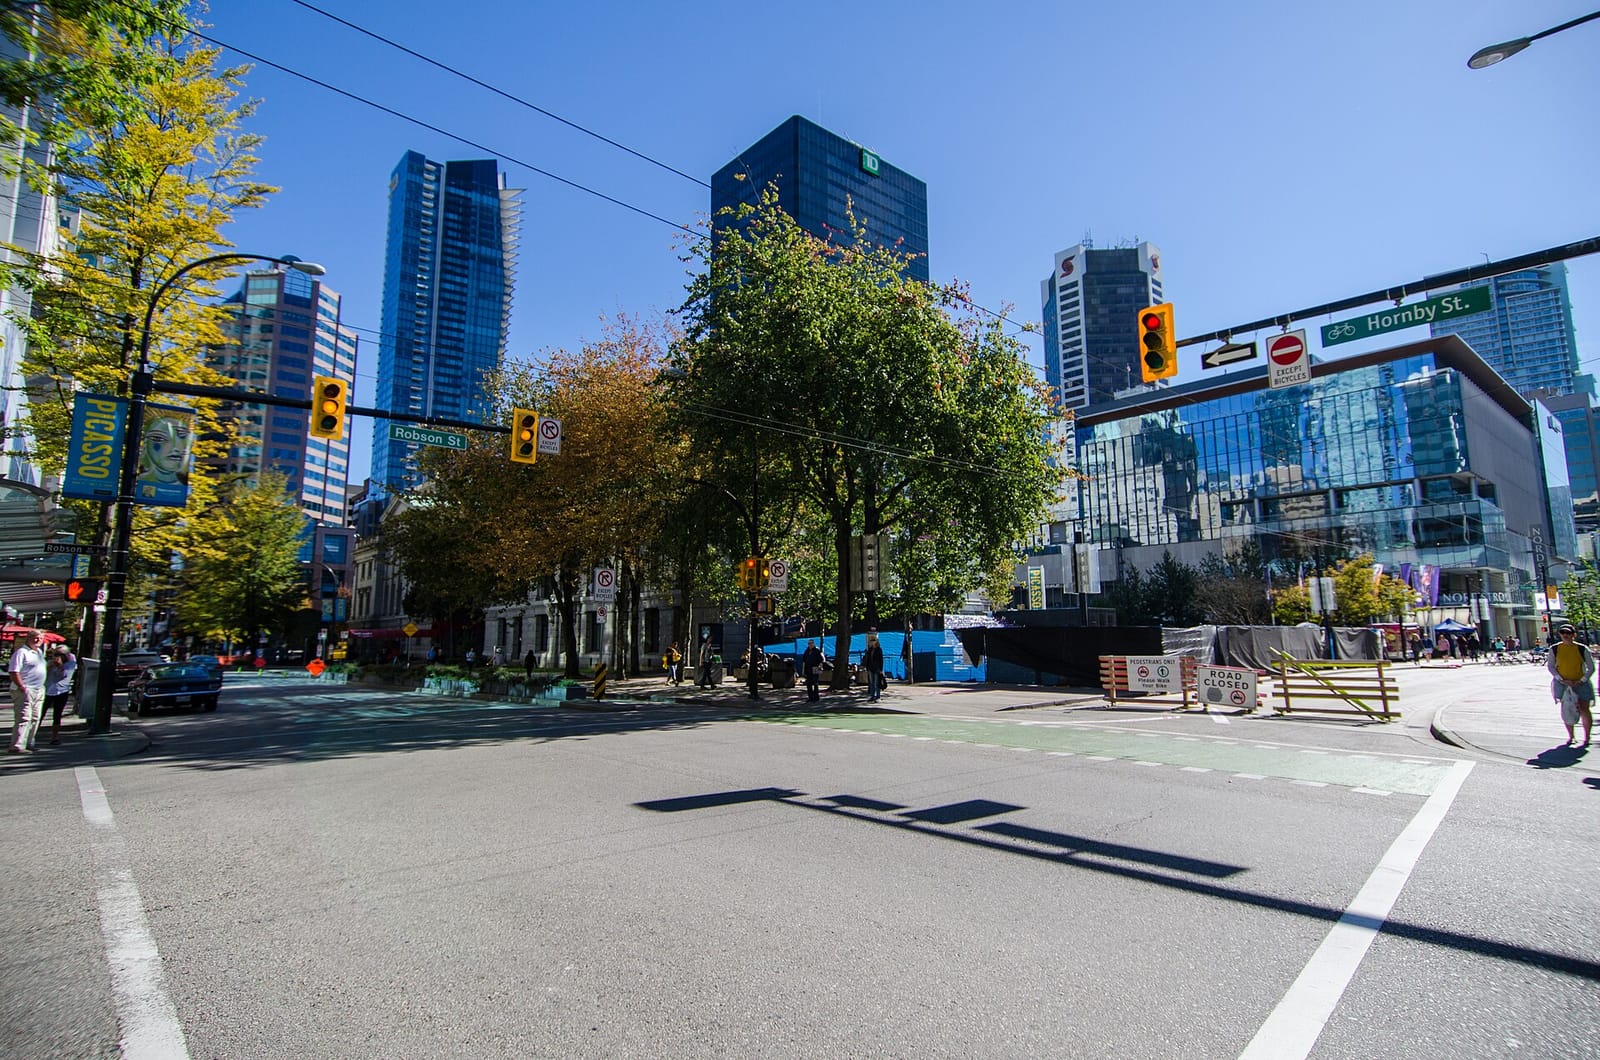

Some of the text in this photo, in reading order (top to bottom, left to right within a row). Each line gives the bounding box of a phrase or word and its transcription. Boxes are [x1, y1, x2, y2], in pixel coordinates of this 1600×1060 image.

[863, 152, 878, 171] TD
[1367, 296, 1470, 331] Hornby St.
[1276, 364, 1302, 376] EXCEPT
[1274, 372, 1307, 385] BICYCLES
[78, 398, 117, 478] PICASSO
[395, 427, 461, 447] Robson St
[46, 544, 82, 553] Robson
[1031, 569, 1042, 608] PICASSO
[1210, 670, 1242, 681] ROAD
[1203, 678, 1249, 690] CLOSED
